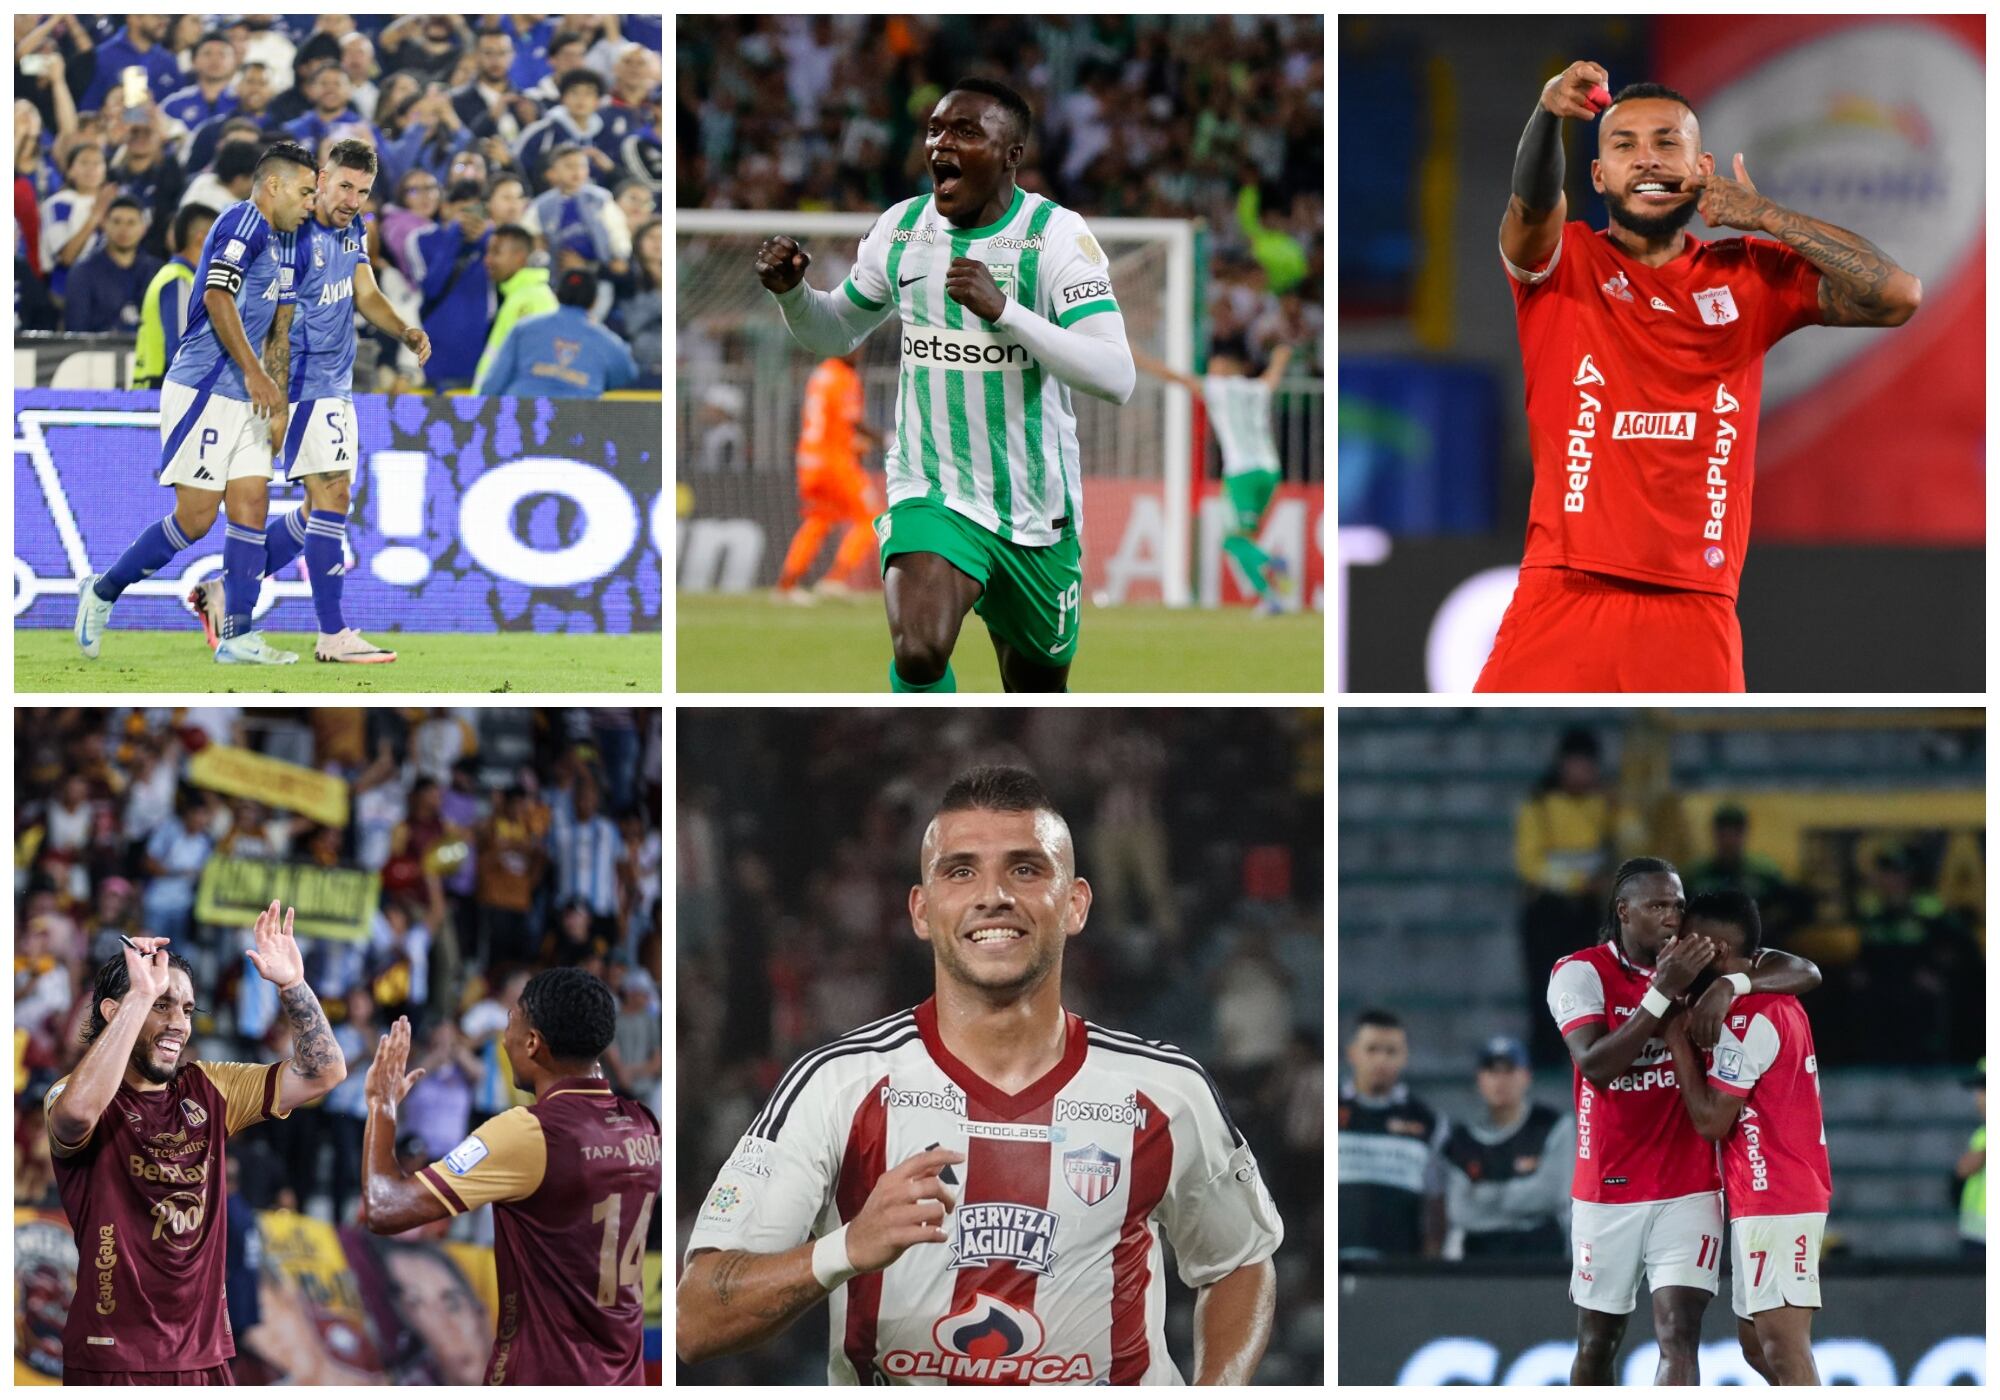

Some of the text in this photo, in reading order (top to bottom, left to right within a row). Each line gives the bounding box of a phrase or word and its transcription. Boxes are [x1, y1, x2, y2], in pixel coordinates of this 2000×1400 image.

[903, 335, 1028, 364] betsson
[1617, 414, 1688, 436] AGUILA
[1564, 391, 1601, 512] BetPlay
[1703, 419, 1737, 541] BetPlay
[1057, 580, 1081, 636] 19
[1609, 1068, 1680, 1091] BetPla
[1579, 1086, 1597, 1160] BetPlay
[580, 1145, 624, 1160] TAPA
[1743, 1123, 1768, 1191] BetPlay
[592, 1192, 656, 1307] 14
[1696, 1234, 1719, 1271] 11
[1794, 1234, 1806, 1274] FILA
[1750, 1251, 1767, 1287] 7
[883, 1350, 1094, 1382] OLIMPICA
